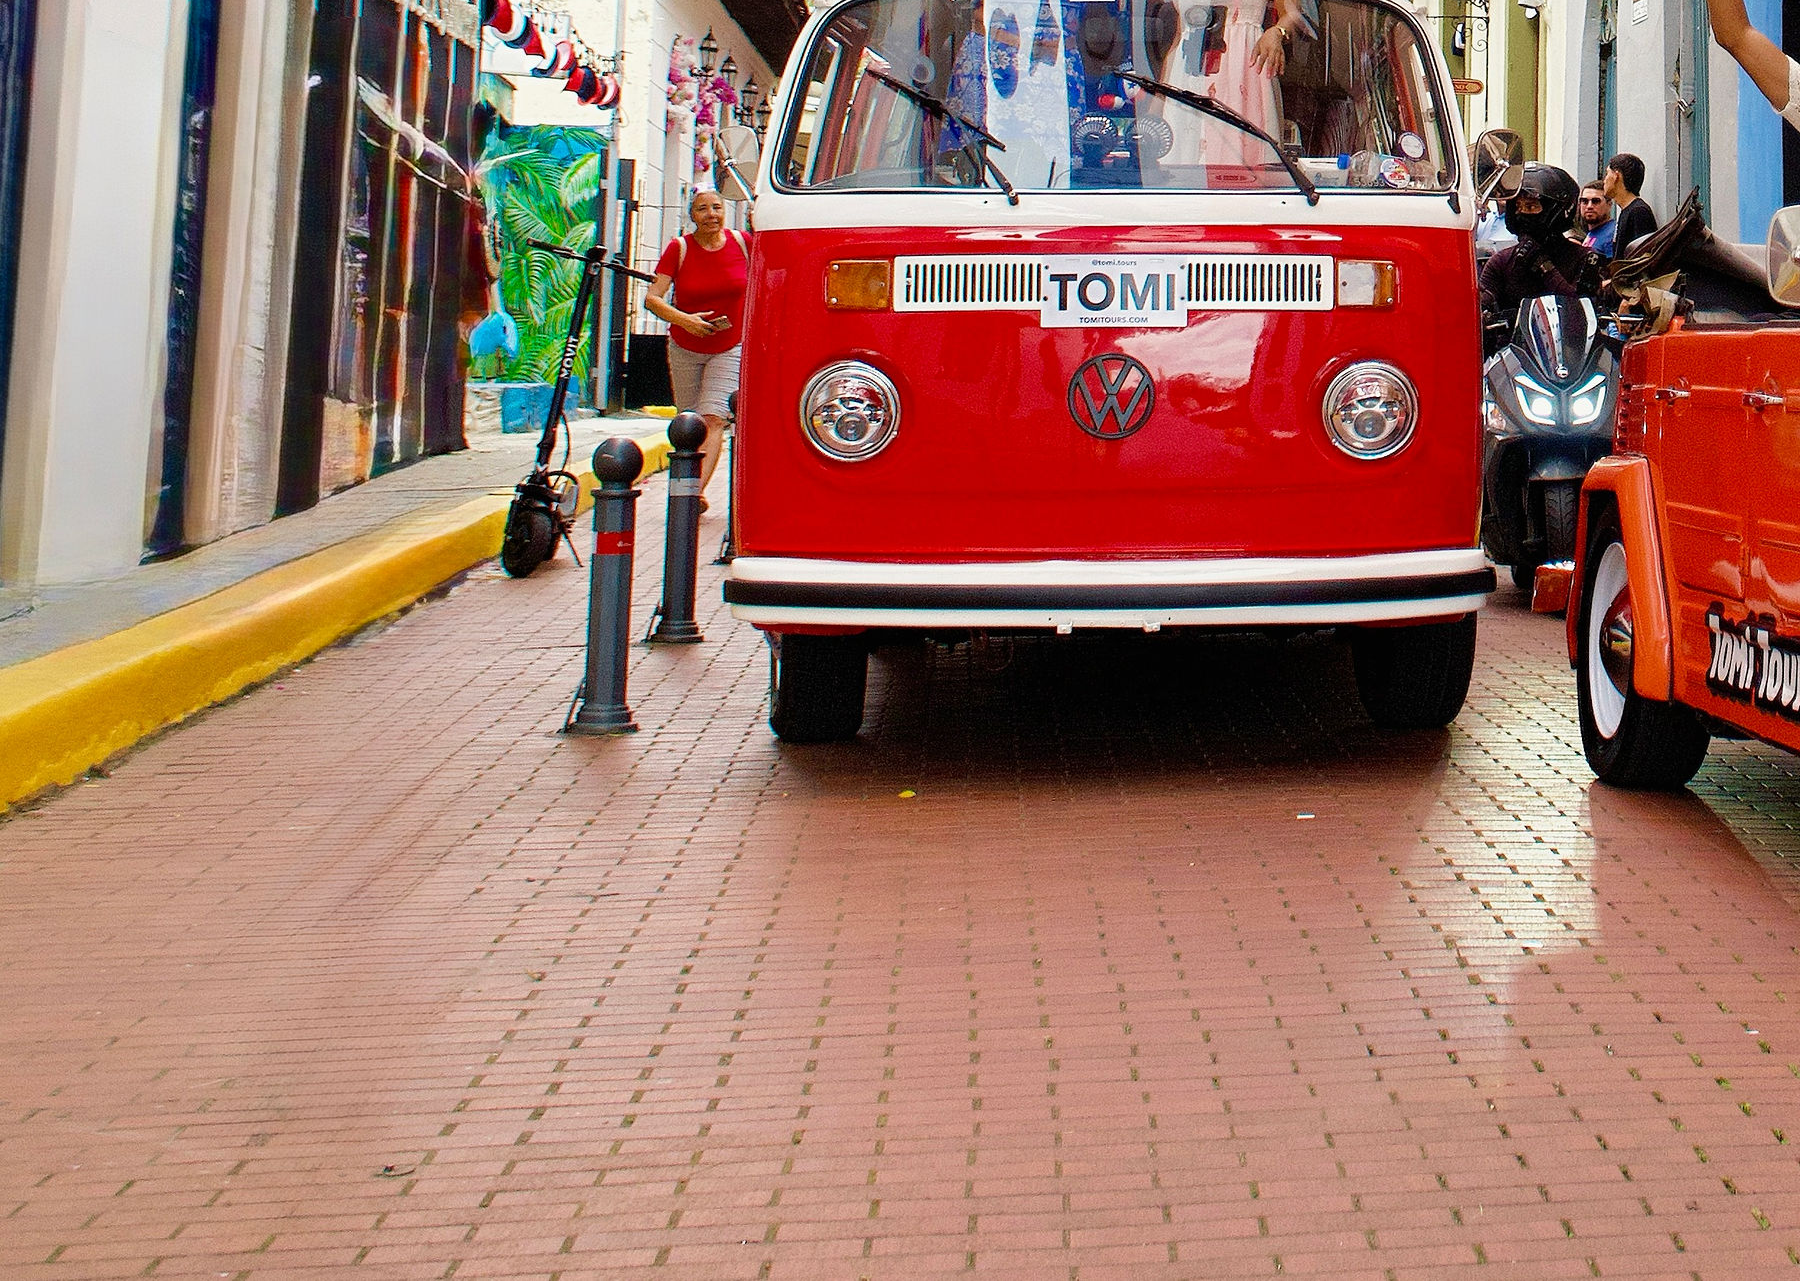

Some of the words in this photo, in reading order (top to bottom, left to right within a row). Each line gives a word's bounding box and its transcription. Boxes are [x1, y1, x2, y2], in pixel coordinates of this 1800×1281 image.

[1091, 259, 1138, 267] @tomi.tours
[1049, 272, 1176, 311] TOMI
[1079, 316, 1149, 324] TOMITOURS.COM
[560, 335, 579, 379] MOVIT
